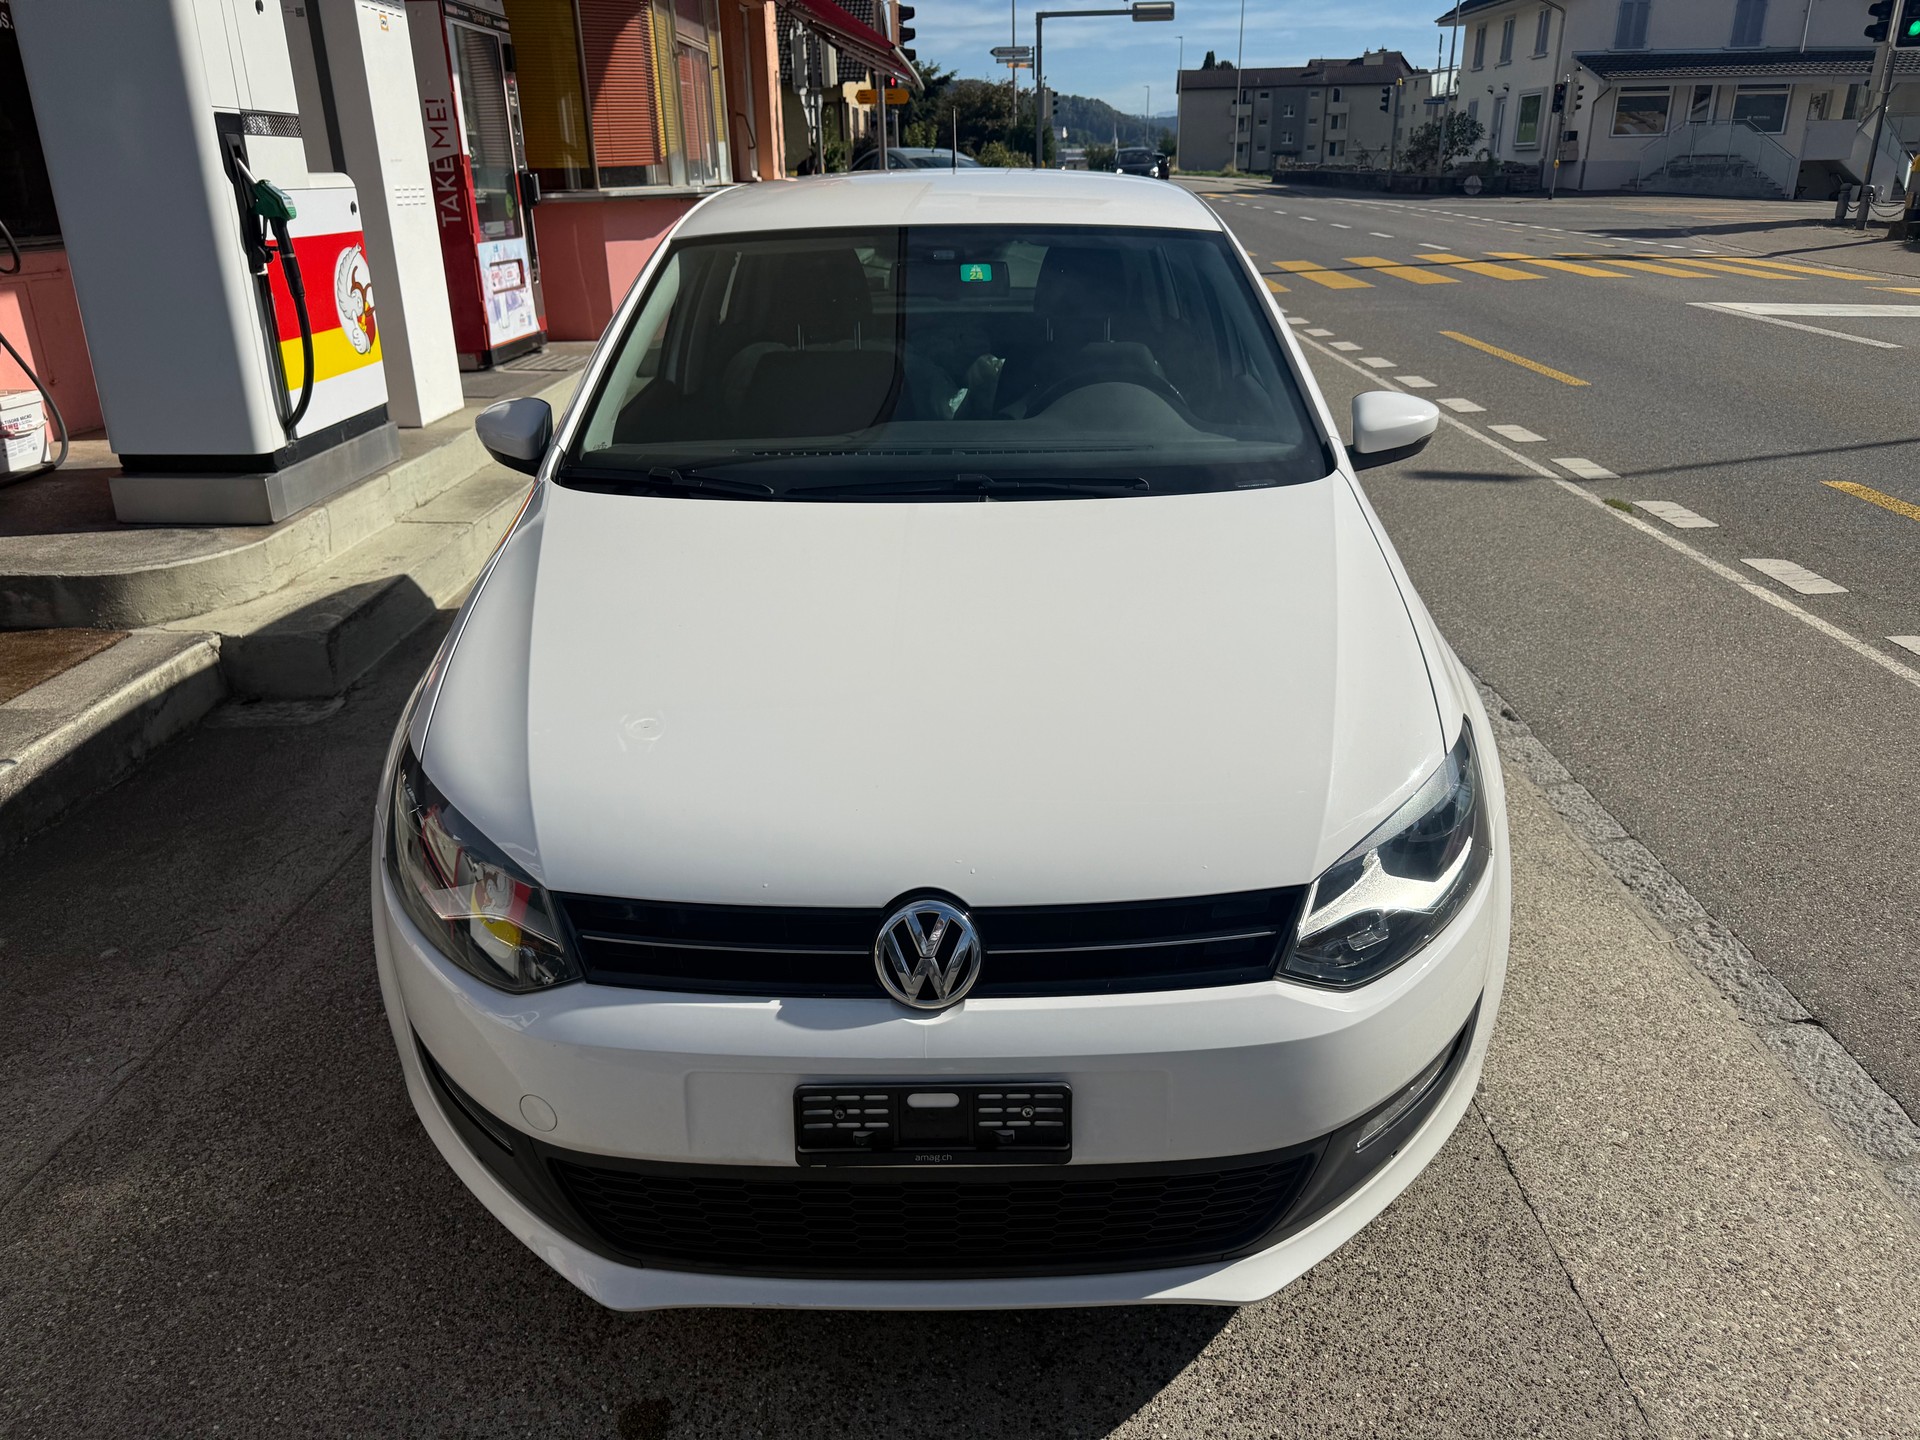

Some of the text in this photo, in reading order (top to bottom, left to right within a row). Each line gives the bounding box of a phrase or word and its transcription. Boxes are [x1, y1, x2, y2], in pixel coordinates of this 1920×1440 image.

[425, 99, 461, 228] TAKE ME!
[877, 904, 979, 1006] VW
[914, 1153, 953, 1163] amag.ch
